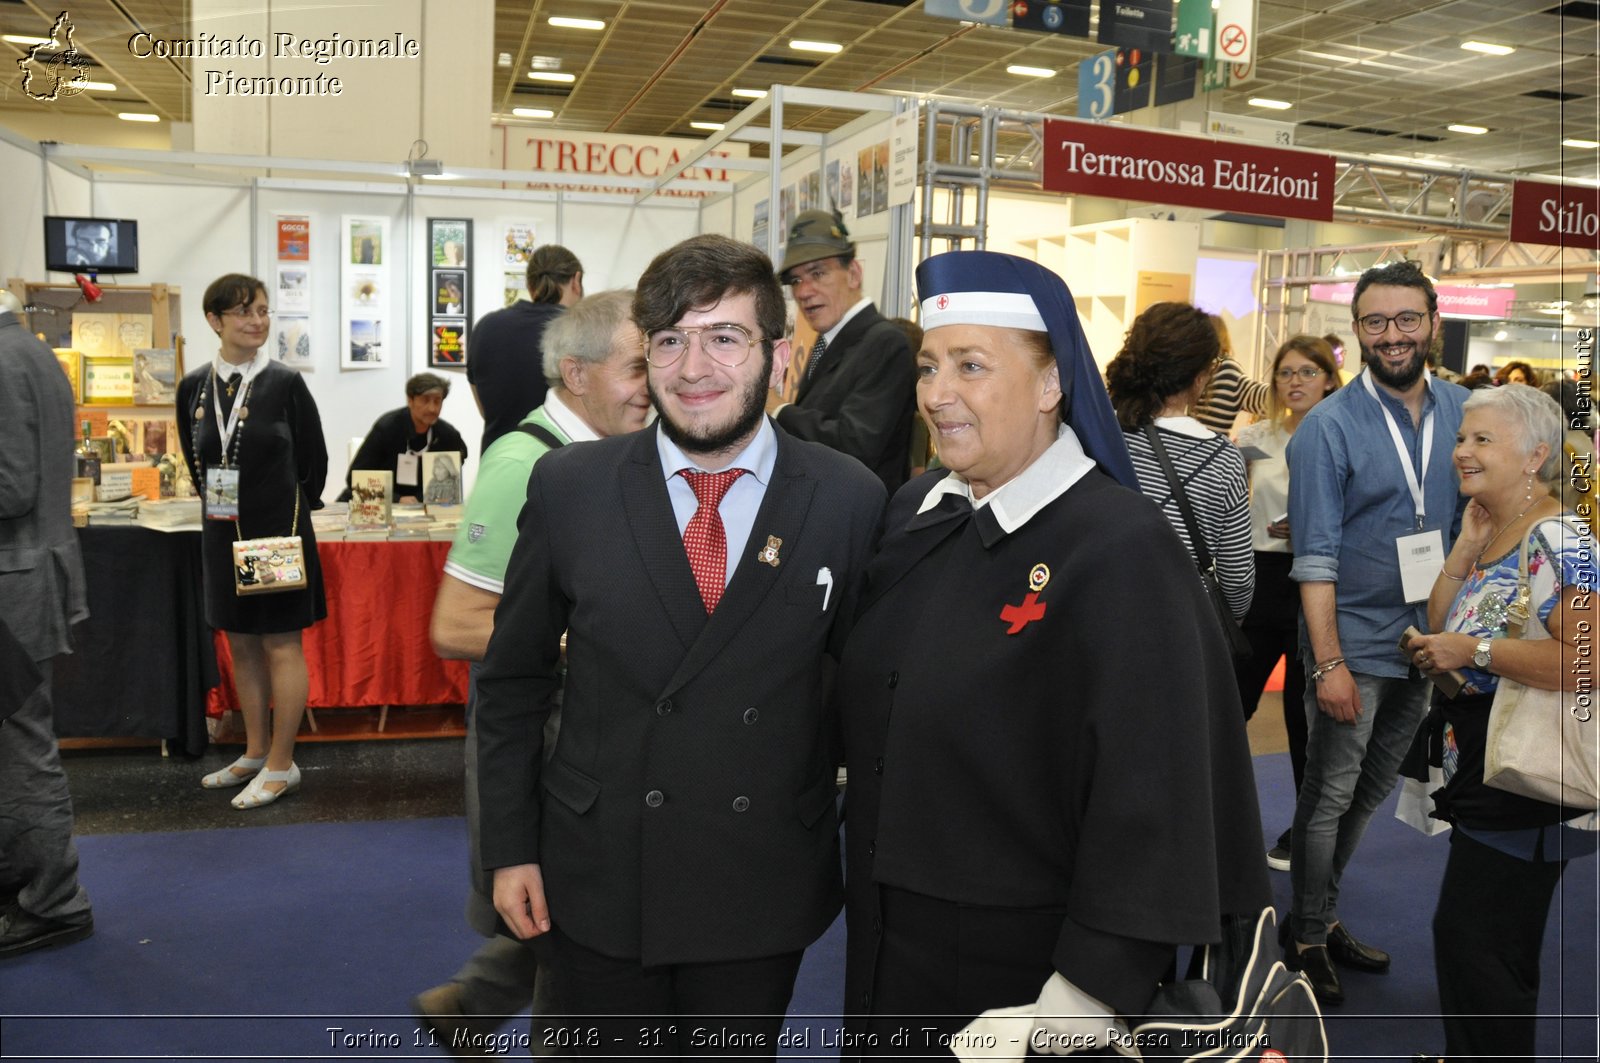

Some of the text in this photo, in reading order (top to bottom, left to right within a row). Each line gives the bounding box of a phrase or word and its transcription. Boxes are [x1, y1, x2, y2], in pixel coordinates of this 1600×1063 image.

[1048, 7, 1059, 25] 5
[1115, 5, 1145, 19] Toilette
[1091, 56, 1113, 118] 3
[1062, 140, 1319, 201] Terrarossa Edizioni
[1539, 198, 1599, 237] Stilo
